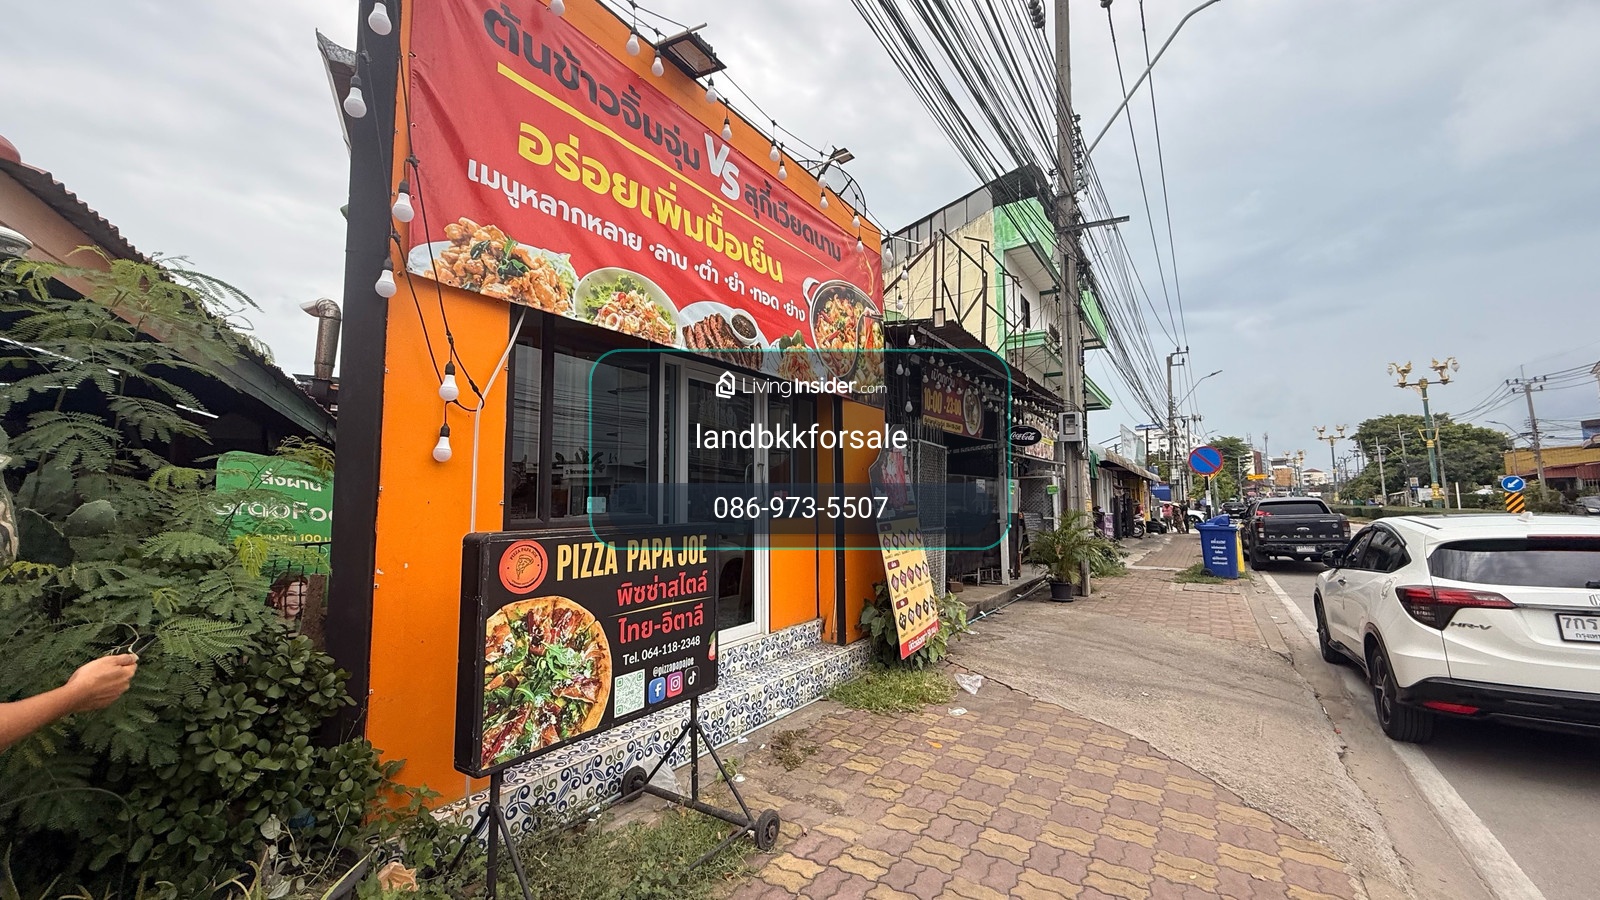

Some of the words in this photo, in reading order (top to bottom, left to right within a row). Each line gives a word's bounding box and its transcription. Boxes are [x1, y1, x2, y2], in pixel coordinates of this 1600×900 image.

[483, 4, 700, 171] ต้นข้าวจิ้มจุ่ม
[467, 159, 642, 252] เมนูหลากหลาย
[518, 122, 784, 284] อร่อยเพิ่มมื้อเย็น
[744, 179, 842, 262] สุกี้เวียดนาม
[260, 467, 322, 492] สั่งผาน
[556, 541, 618, 581] PIZZA
[627, 537, 674, 573] PAPA
[677, 534, 708, 566] JOE
[617, 570, 708, 606] พิซซ่าสไตล์
[1450, 621, 1492, 631] HR-V
[622, 651, 640, 666] Tel.
[641, 635, 701, 661] 064-118-2348
